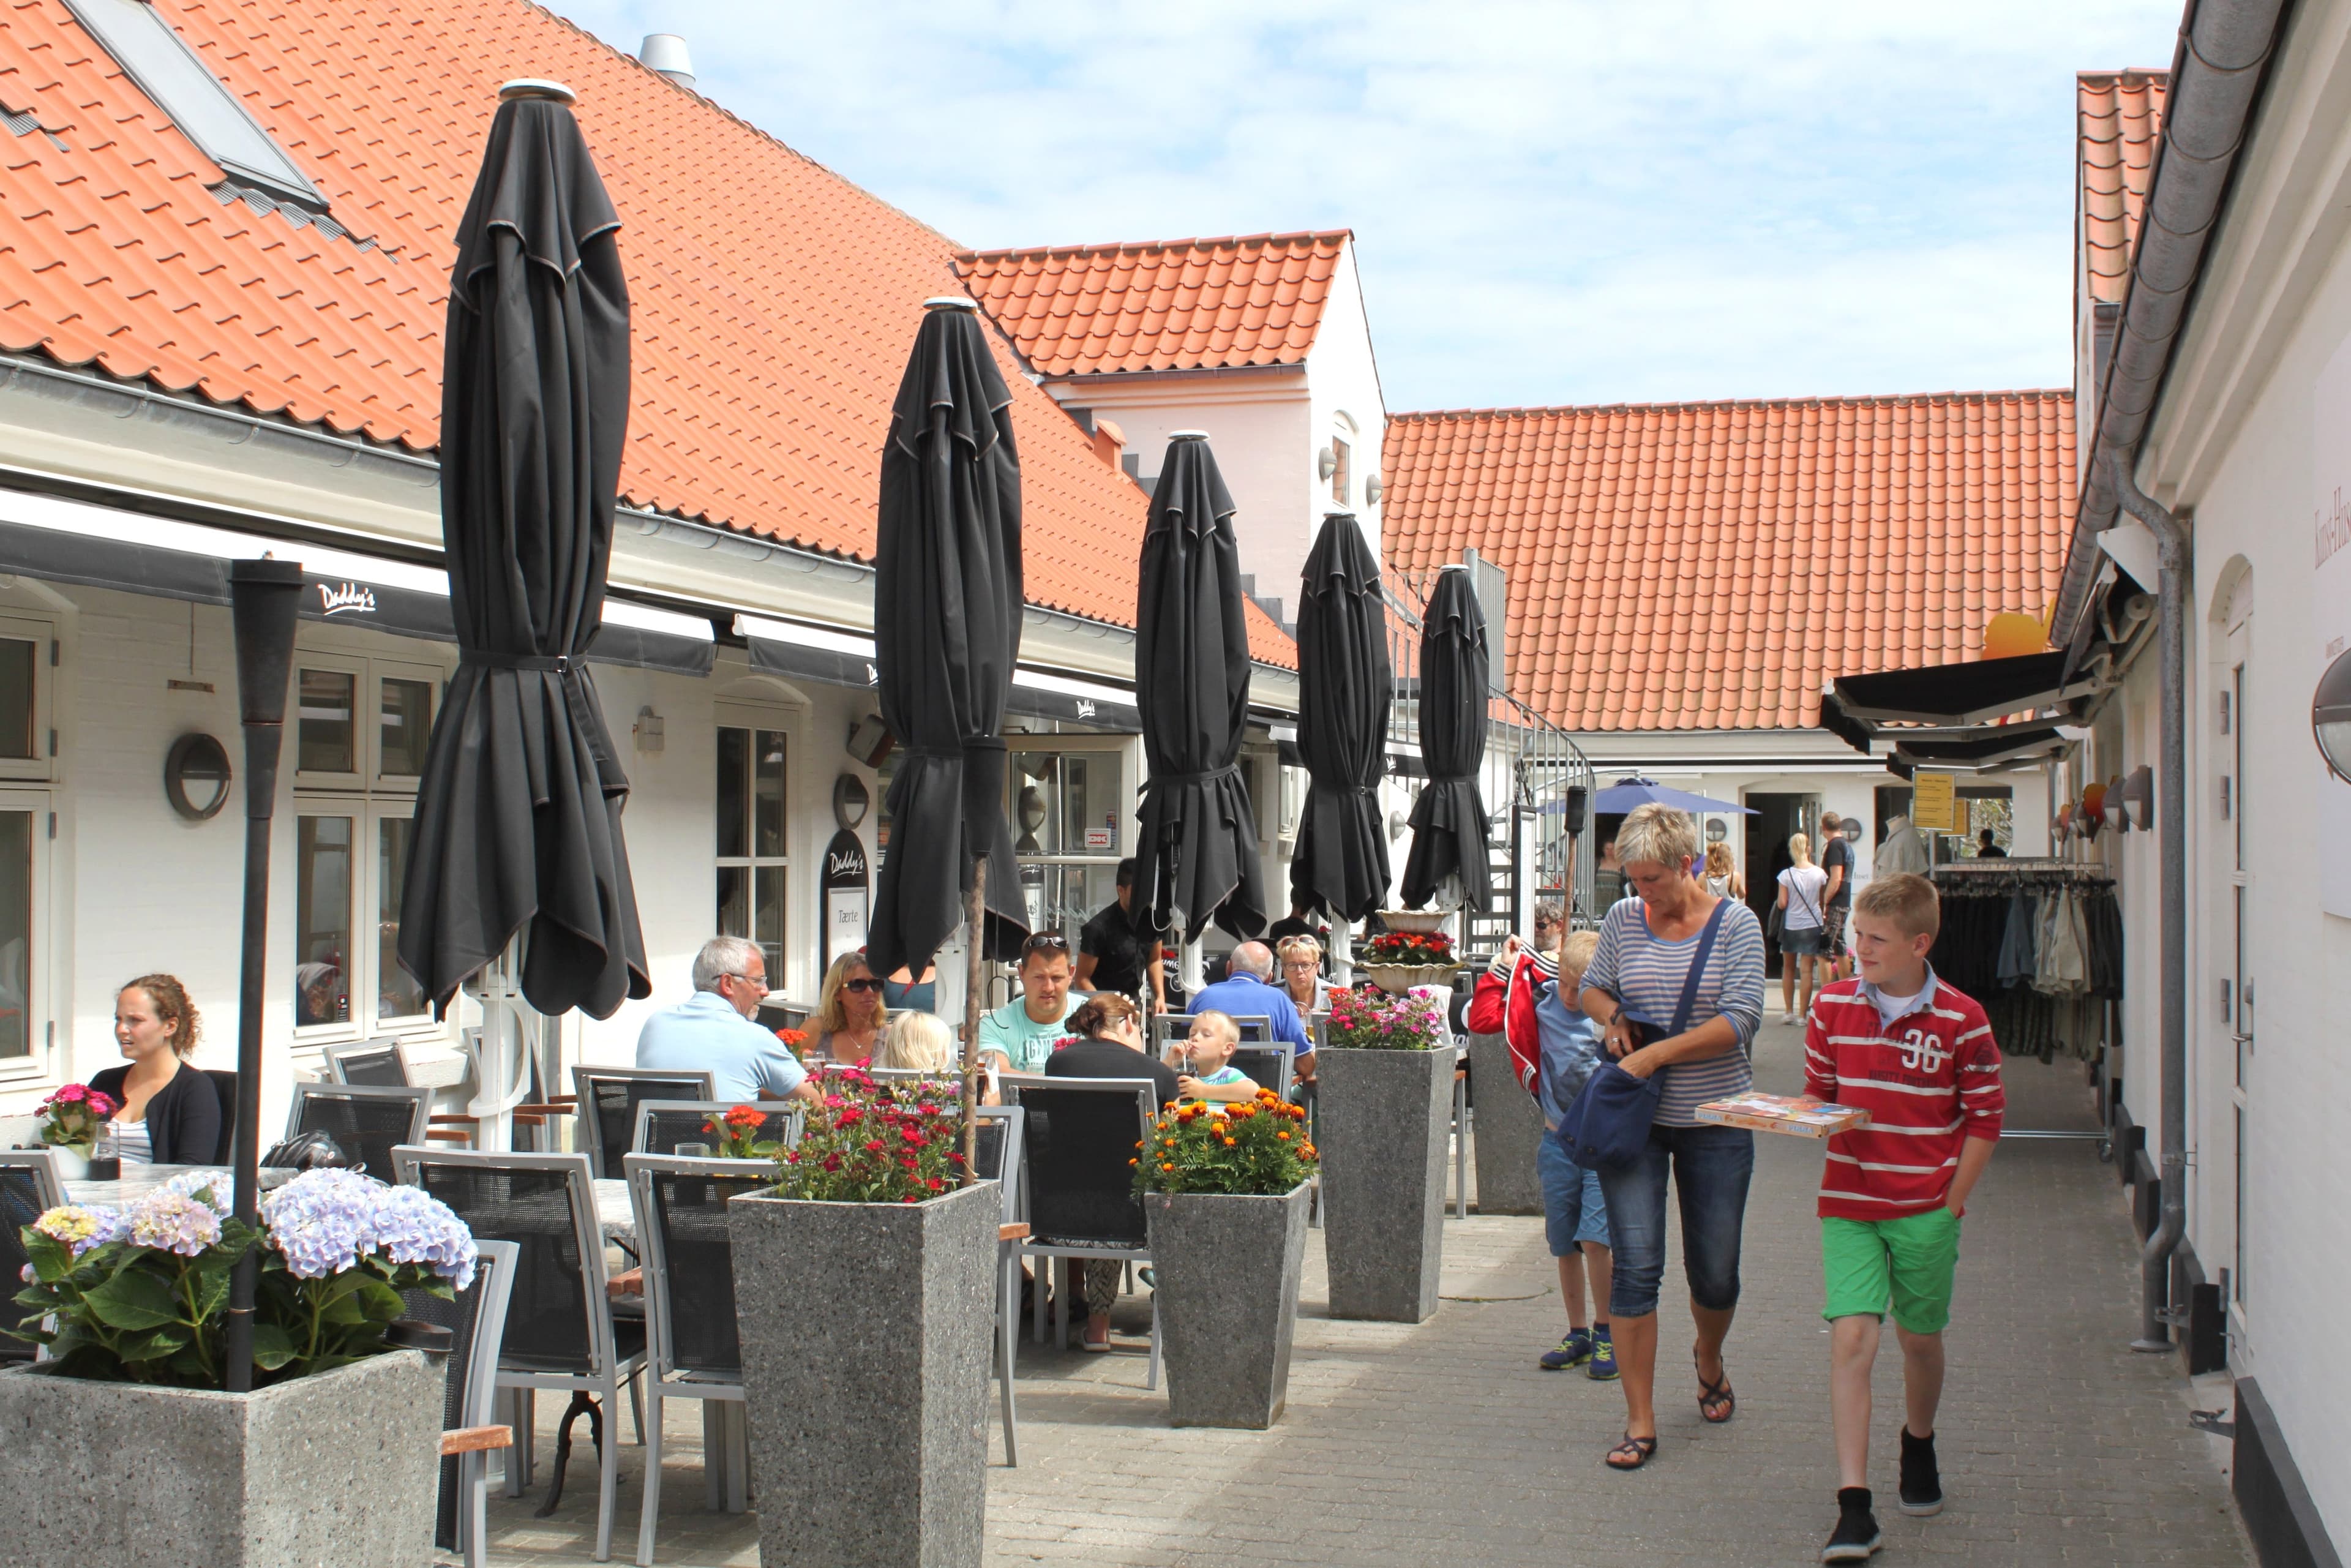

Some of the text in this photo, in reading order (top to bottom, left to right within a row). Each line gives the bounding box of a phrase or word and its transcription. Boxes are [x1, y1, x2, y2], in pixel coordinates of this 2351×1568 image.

[317, 582, 375, 612] Daddy's
[830, 850, 863, 876] Daddy's
[839, 910, 858, 923] Tærte
[1902, 1029, 1941, 1073] 36
